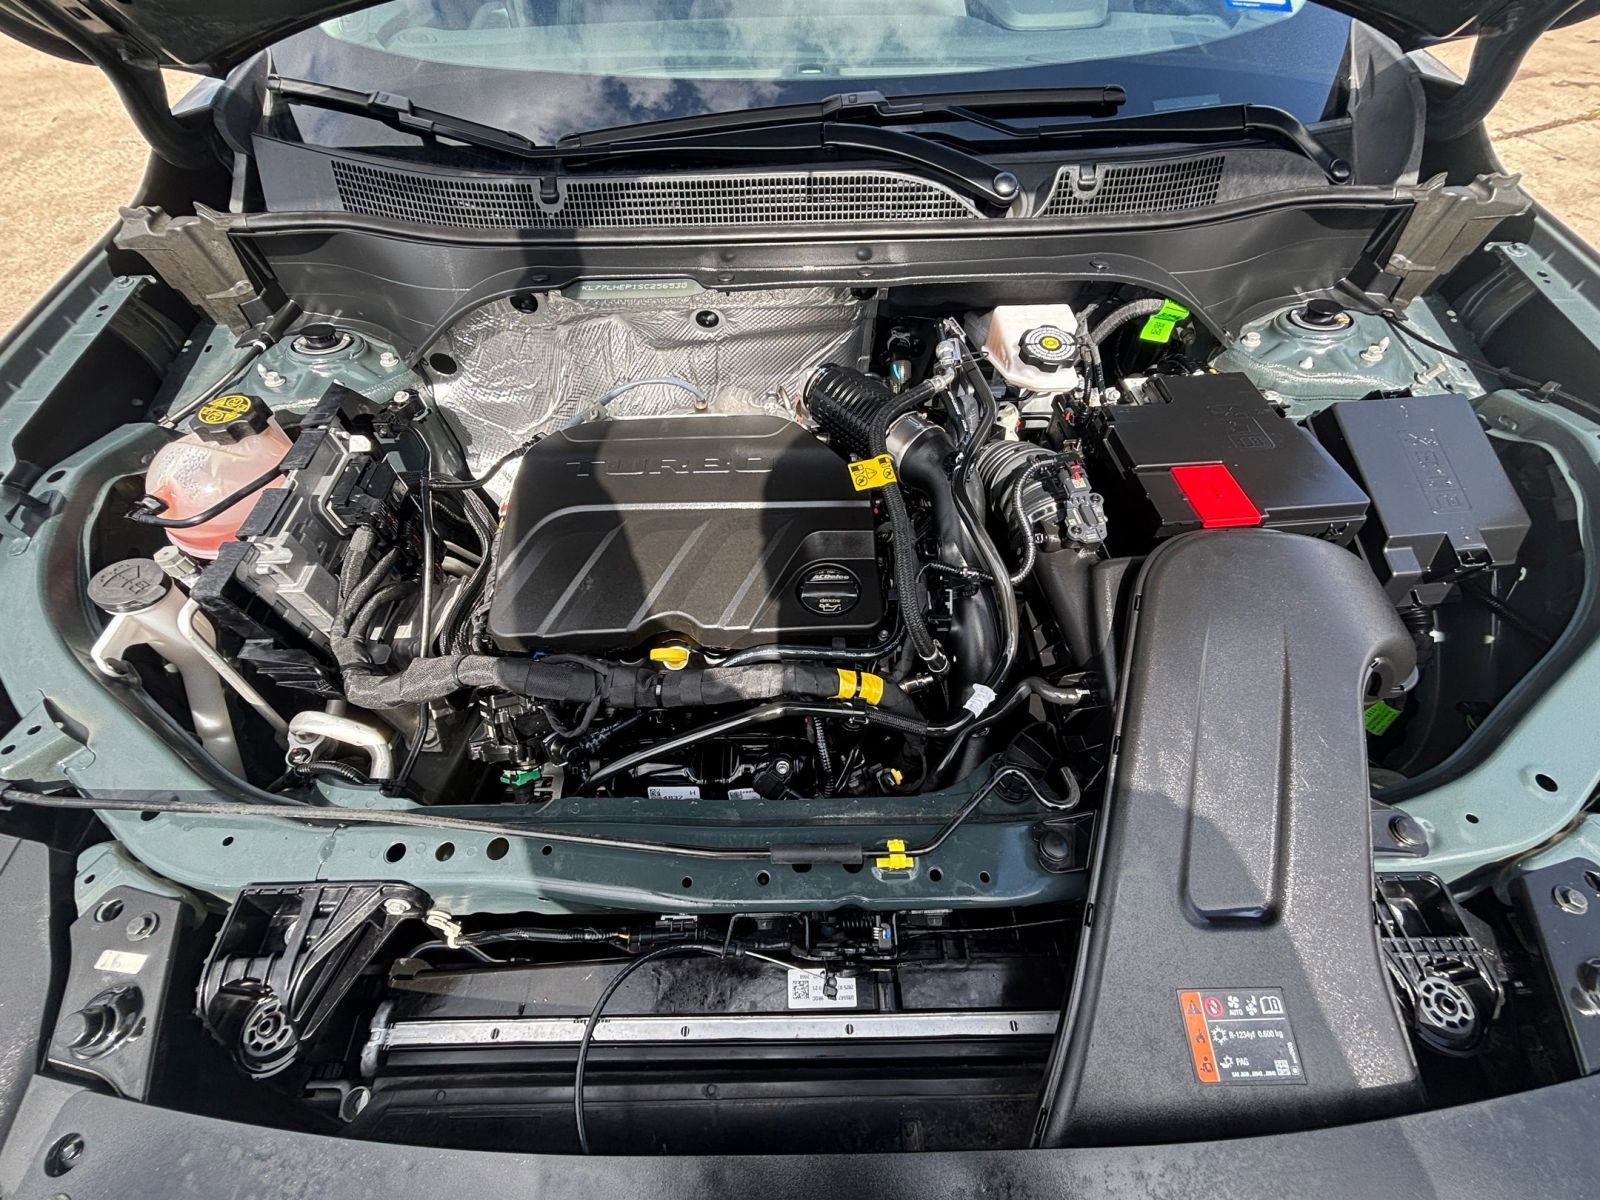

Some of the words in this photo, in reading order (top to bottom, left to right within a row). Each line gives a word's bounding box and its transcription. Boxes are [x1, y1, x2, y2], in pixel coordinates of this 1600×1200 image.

[566, 456, 773, 476] TURBO
[1229, 1031, 1256, 1040] R-1234yf
[1275, 1030, 1284, 1039] kg
[1235, 1057, 1249, 1066] PAG
